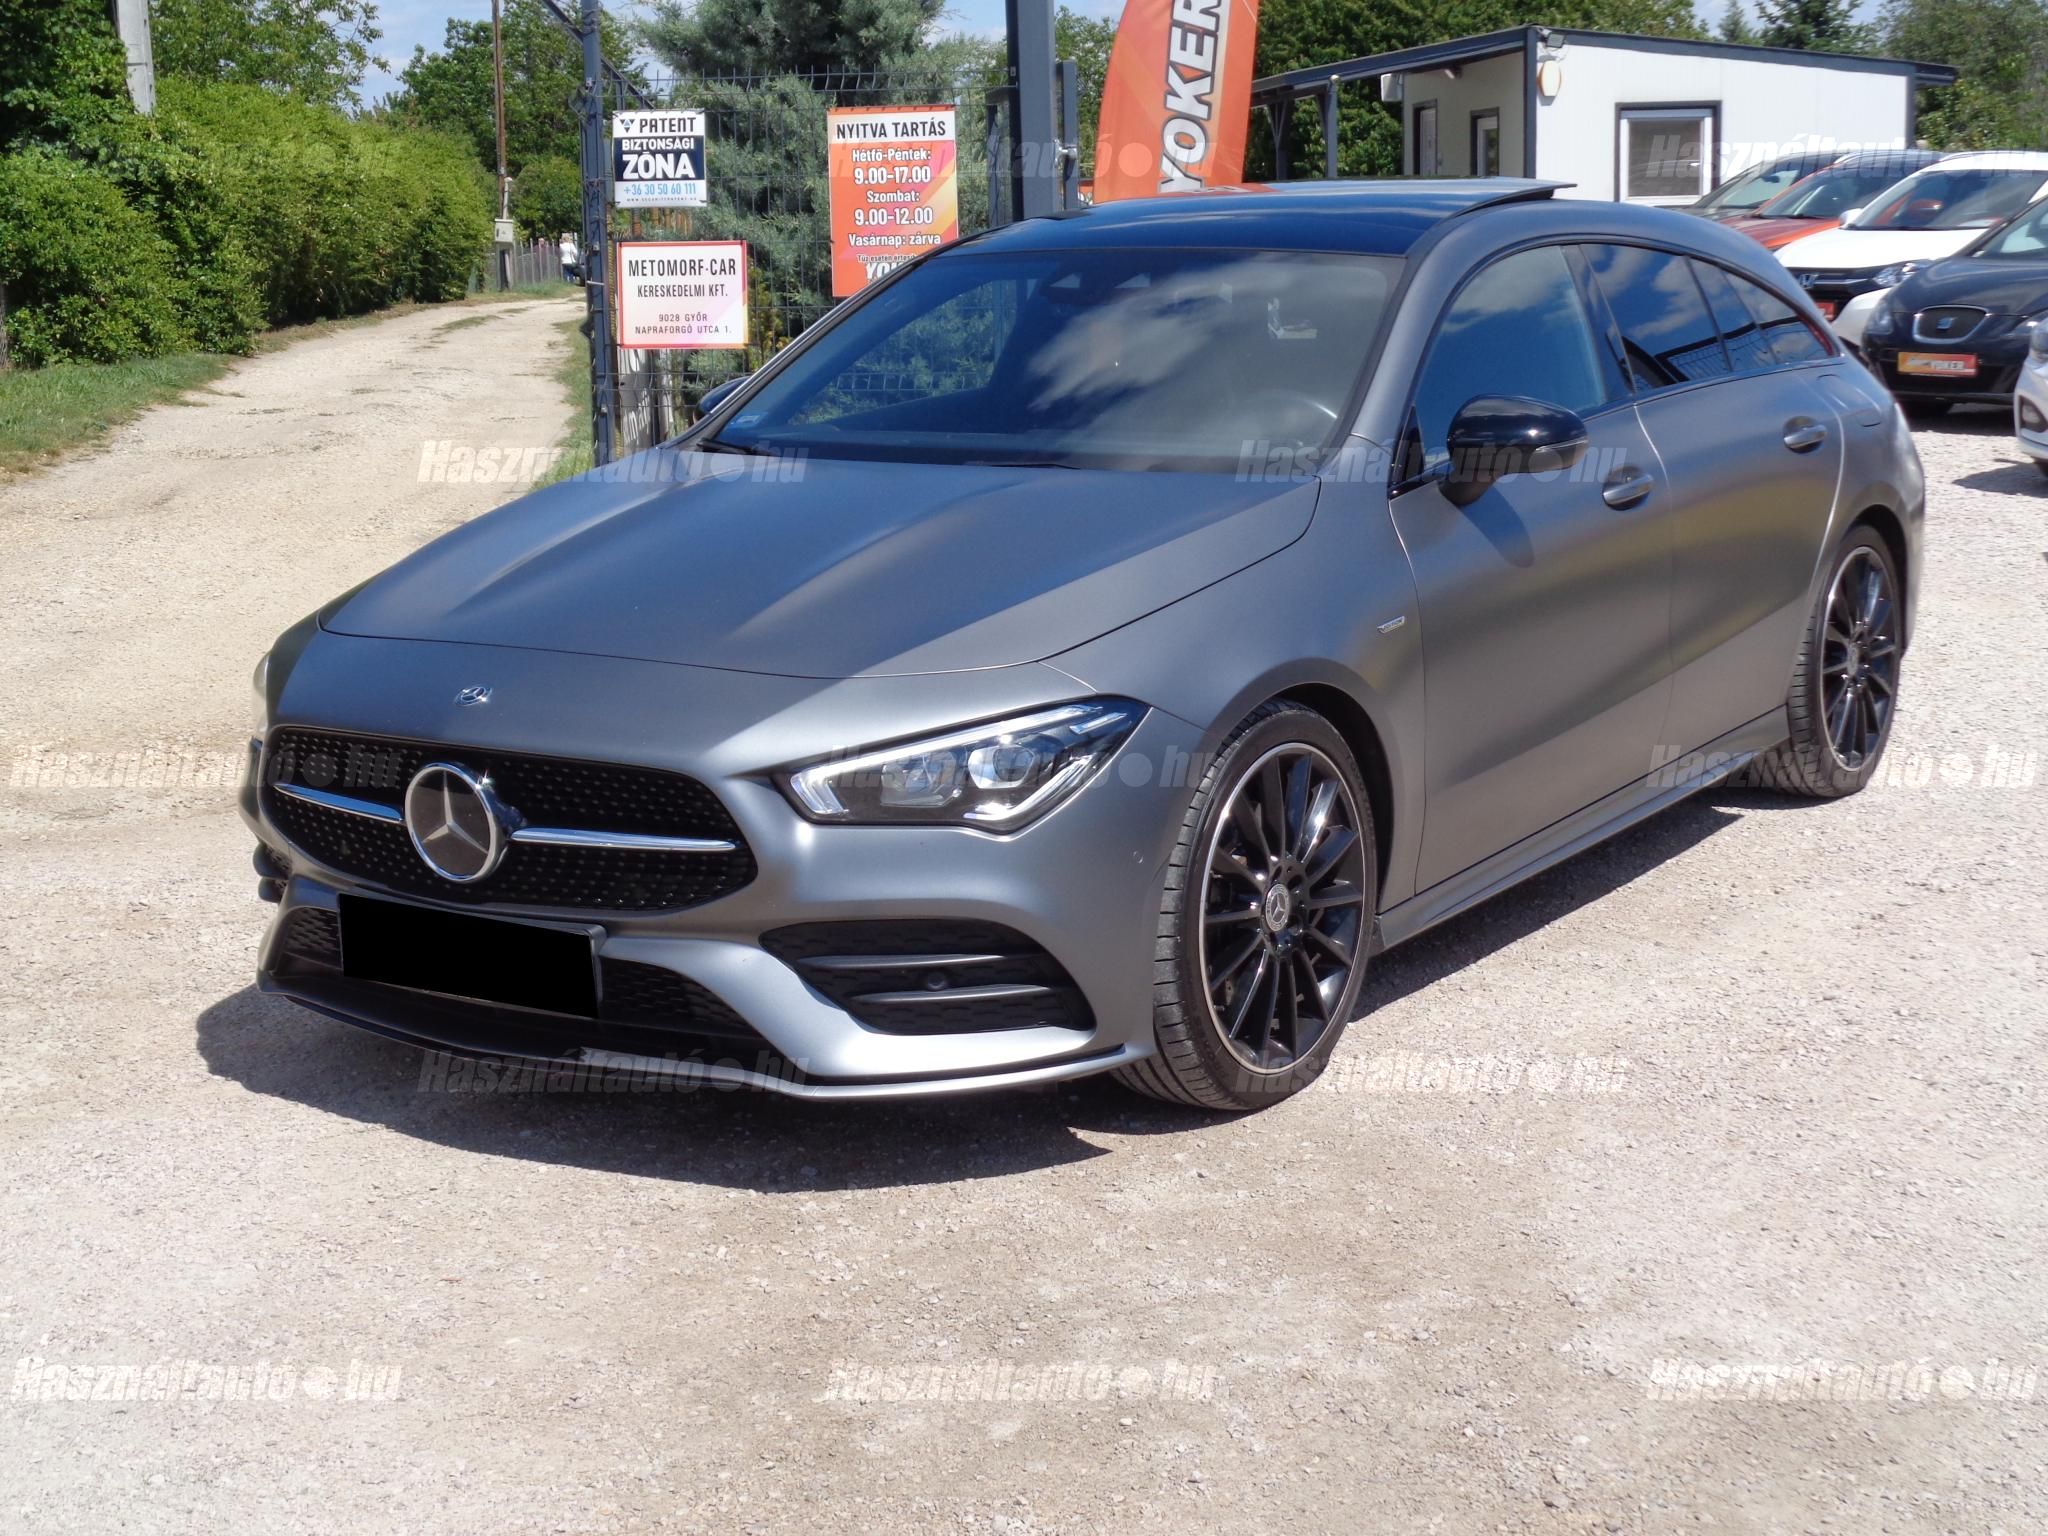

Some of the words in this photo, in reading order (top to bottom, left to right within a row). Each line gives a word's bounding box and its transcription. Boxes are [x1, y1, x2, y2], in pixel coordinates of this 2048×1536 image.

[640, 117, 696, 133] PATENT
[836, 122, 888, 139] NYITVA
[891, 117, 946, 138] TARTÁS
[622, 137, 694, 151] BIZTONSÁGI
[854, 166, 931, 185] 9.00-17.00
[624, 183, 642, 195] +36
[644, 183, 655, 195] 30
[657, 183, 668, 195] 50
[670, 183, 681, 195] 60
[685, 182, 696, 194] 111
[866, 190, 920, 203] Szombat:
[854, 207, 933, 226] 9.00-12.00
[848, 233, 906, 248] Vasárnap:
[909, 231, 941, 245] zárva
[628, 258, 736, 277] METOMORF-CAR
[637, 284, 705, 298] KERESKEDELMI
[708, 283, 728, 297] KFT.
[658, 313, 680, 322] 9028
[635, 324, 693, 335] NAPRAFORGÓ
[697, 325, 720, 334] UTCA
